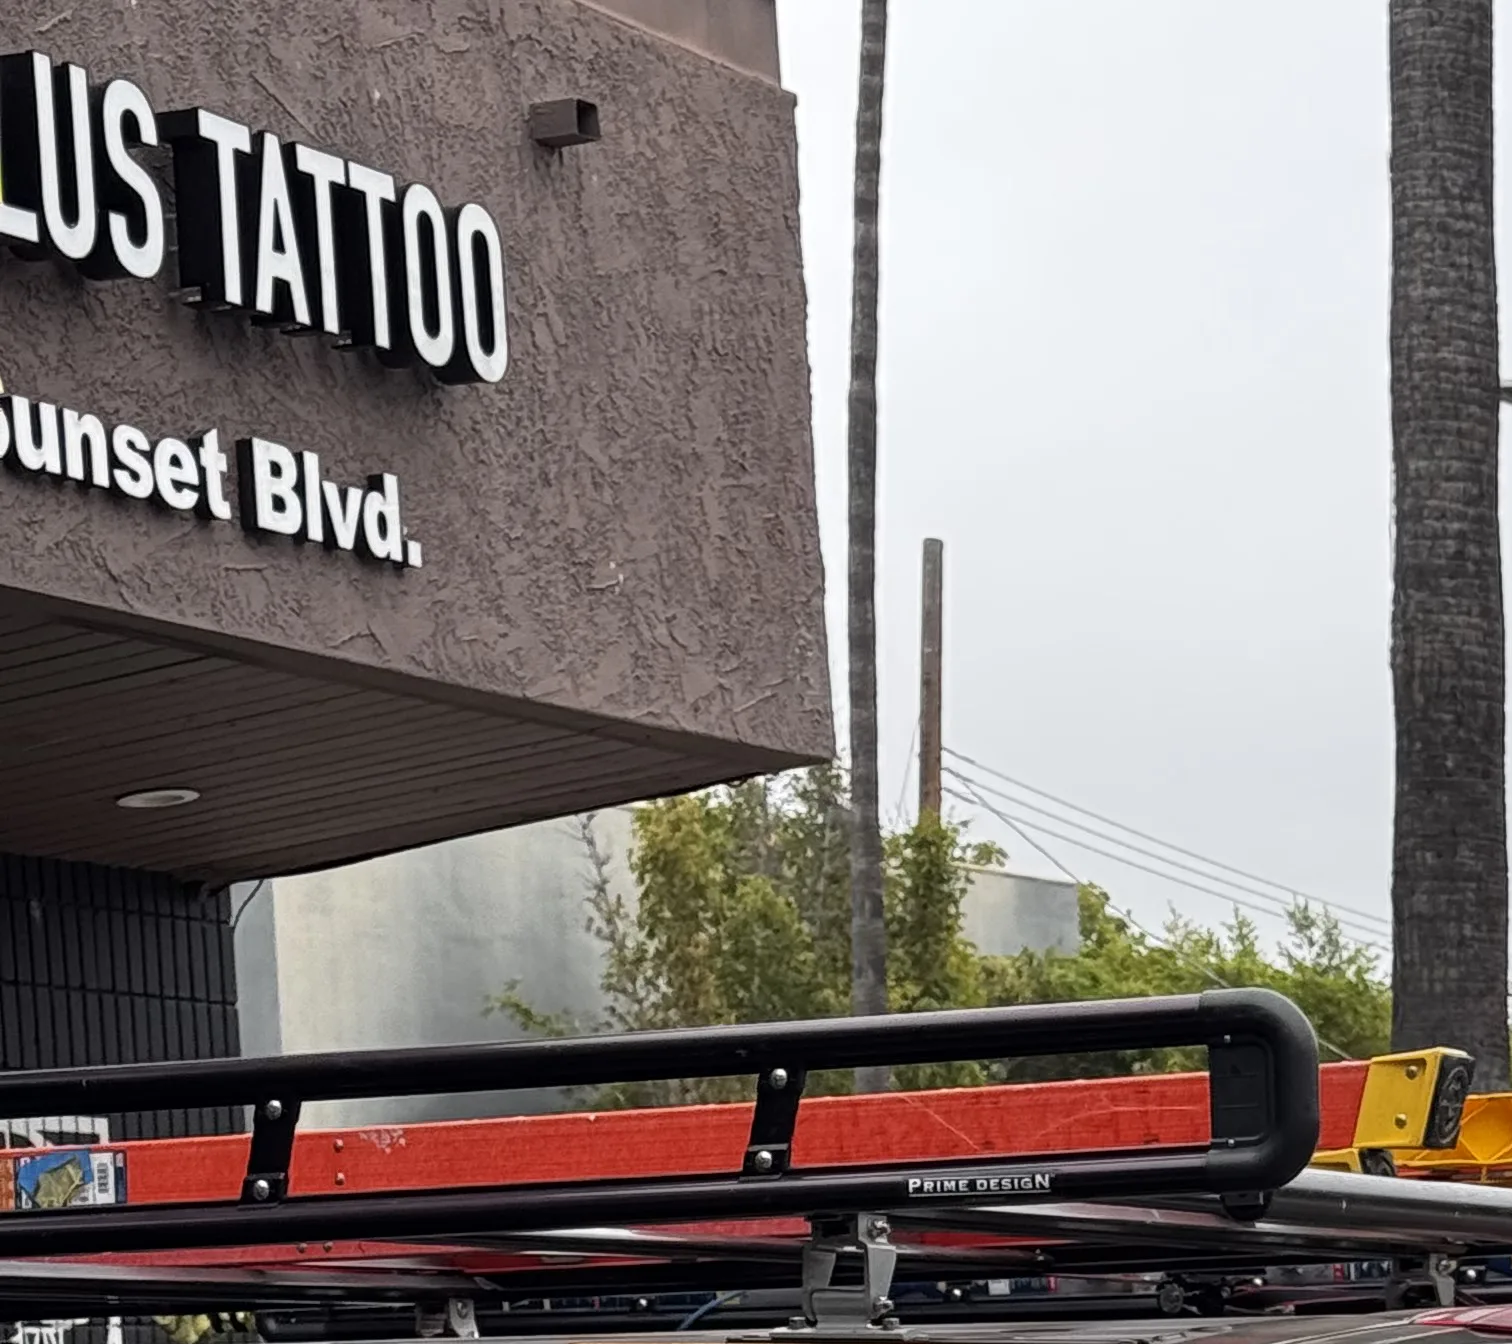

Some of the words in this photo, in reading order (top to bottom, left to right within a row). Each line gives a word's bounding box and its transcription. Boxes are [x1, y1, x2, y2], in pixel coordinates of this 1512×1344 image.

[199, 107, 508, 385] TATTOO
[252, 437, 422, 568] Blvd.
[908, 1178, 969, 1193] PRIME
[976, 1174, 1050, 1190] DESIGN
